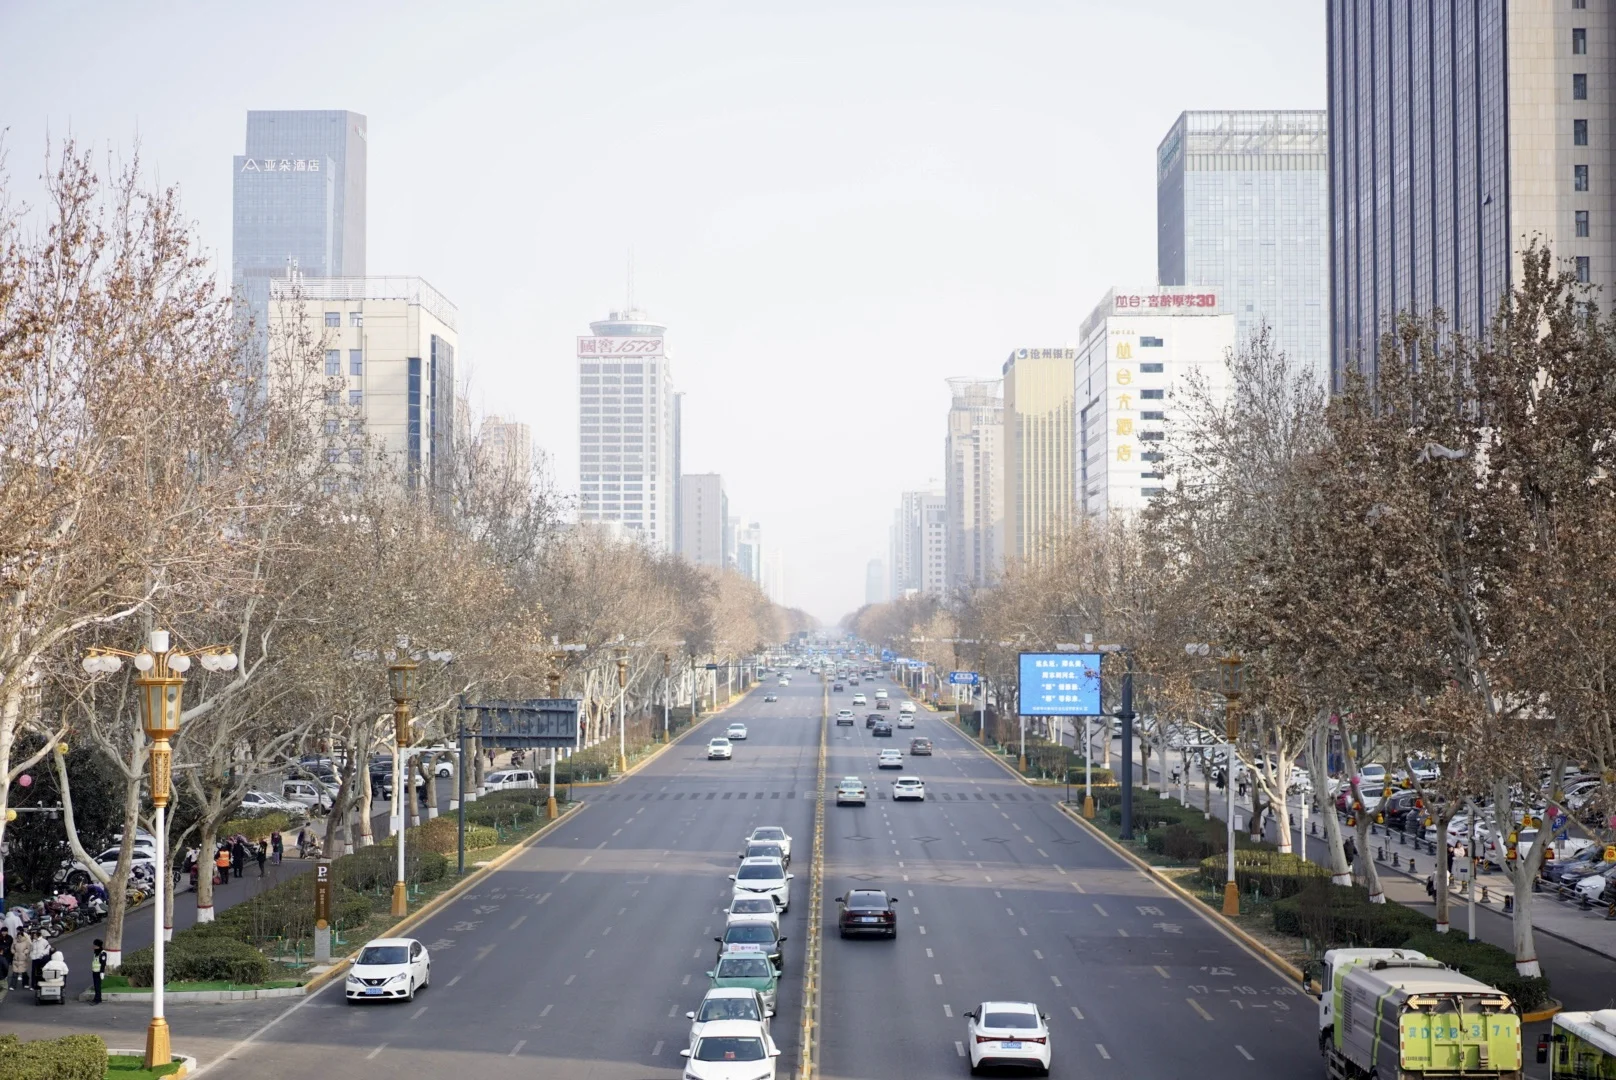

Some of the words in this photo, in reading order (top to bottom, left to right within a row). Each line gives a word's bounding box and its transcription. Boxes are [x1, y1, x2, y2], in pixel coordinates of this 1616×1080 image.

[264, 159, 320, 172] 亚朵酒店
[1030, 348, 1074, 359] 沧州银行
[1116, 341, 1132, 462] 丛台大酒店
